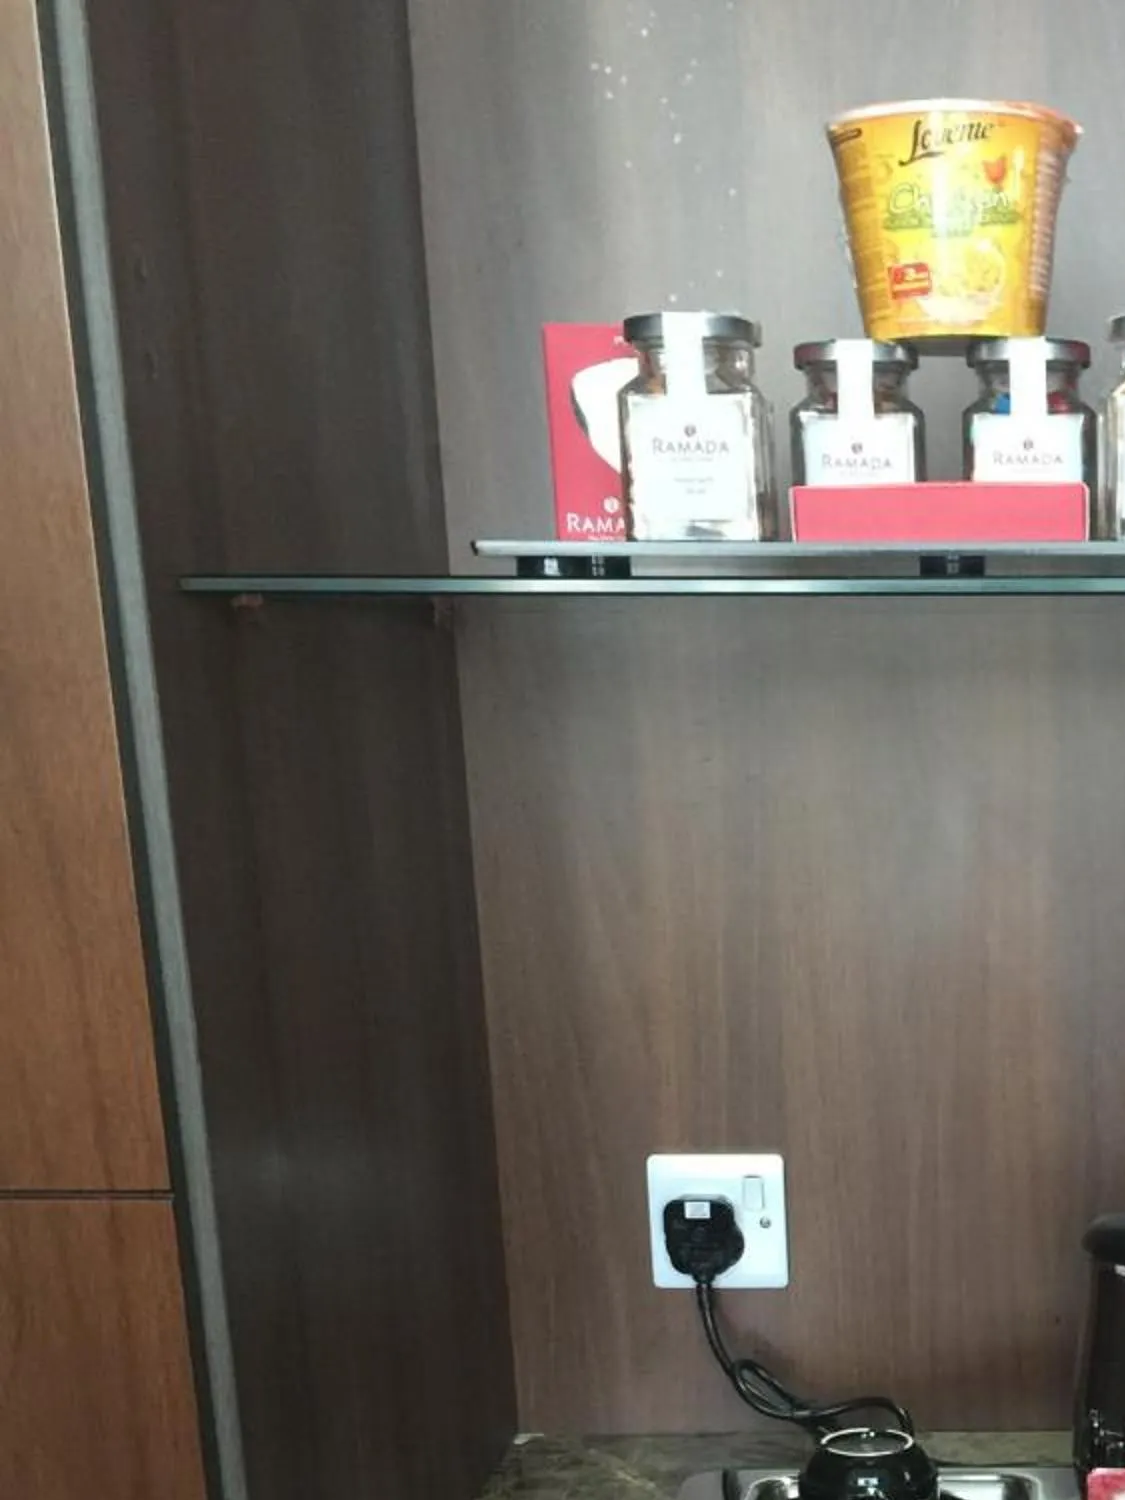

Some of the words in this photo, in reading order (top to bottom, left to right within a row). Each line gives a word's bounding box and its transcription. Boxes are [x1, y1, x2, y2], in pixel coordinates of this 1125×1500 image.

[652, 436, 730, 455] RAMADA
[821, 452, 893, 469] RAMADA
[992, 449, 1064, 466] RAMADA
